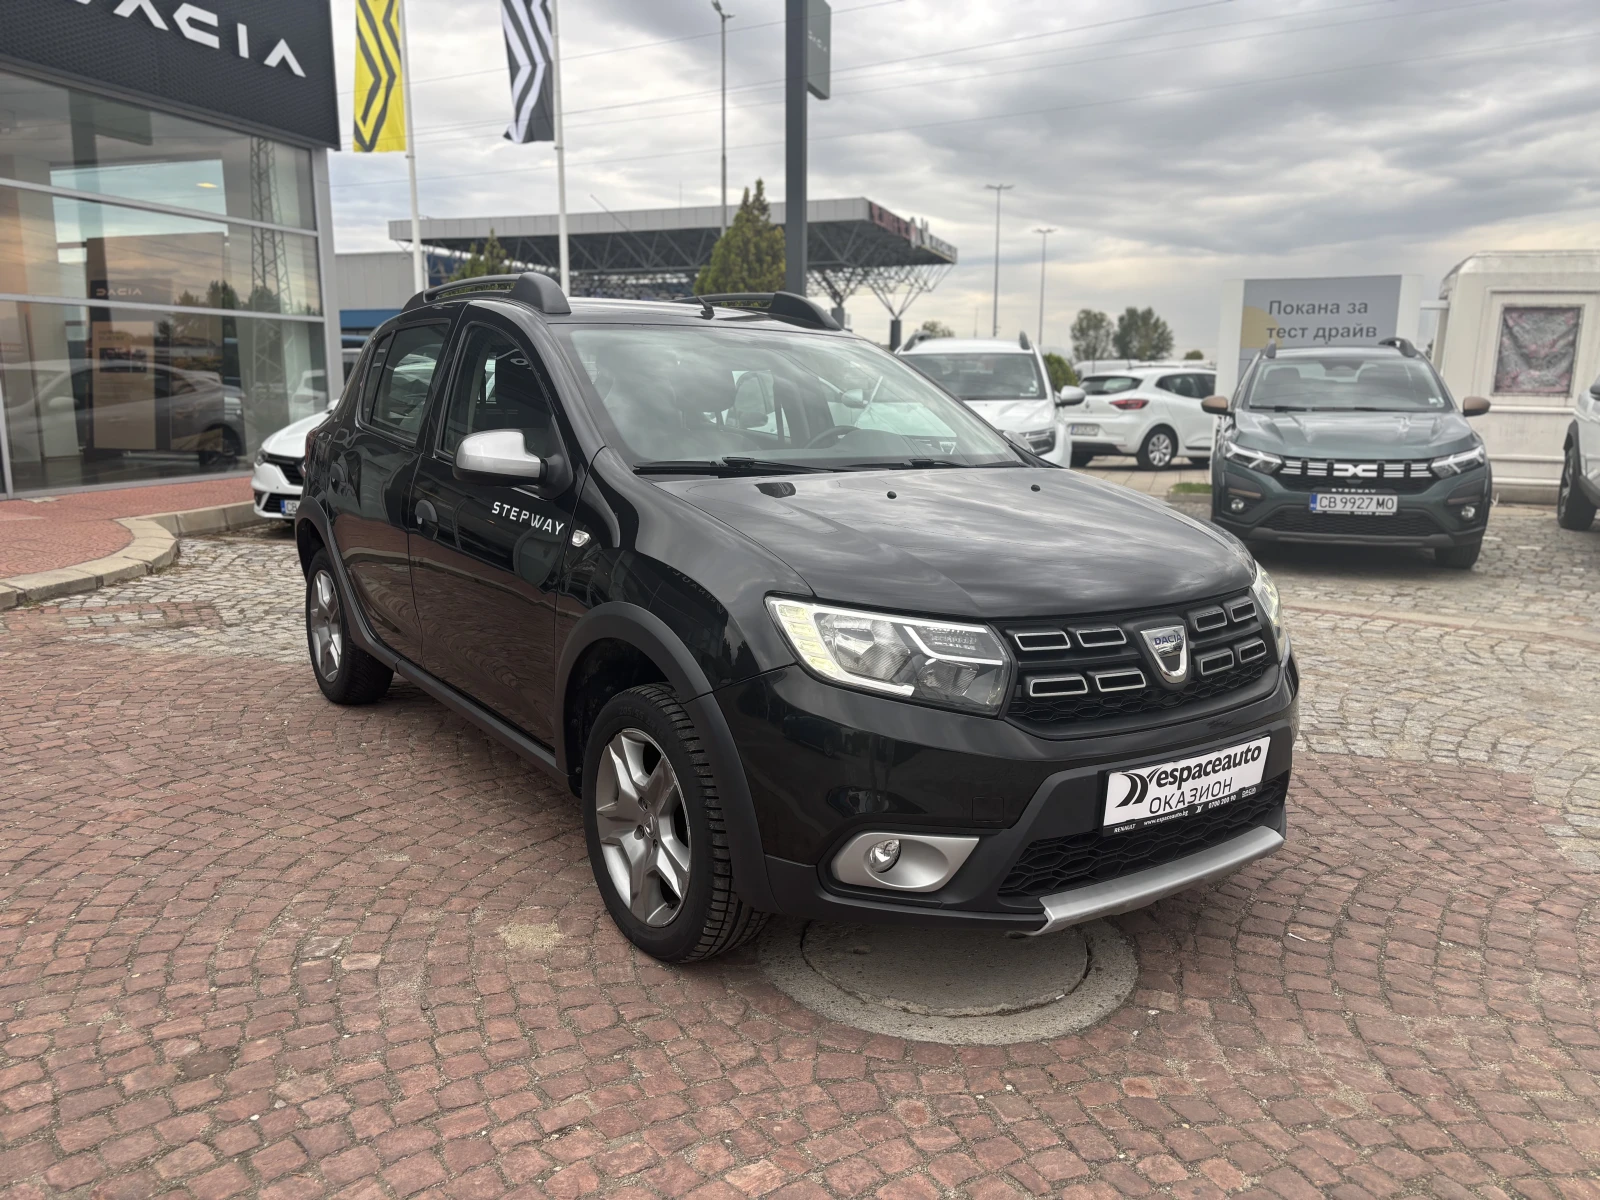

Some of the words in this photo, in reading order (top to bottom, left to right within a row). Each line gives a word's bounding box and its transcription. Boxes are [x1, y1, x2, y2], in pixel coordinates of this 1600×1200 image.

[75, 0, 306, 78] ACIA
[96, 287, 142, 296] DACIA
[1268, 300, 1341, 316] Покана
[1347, 302, 1369, 315] за
[1266, 327, 1309, 339] тест
[1313, 323, 1377, 342] драйв
[1340, 497, 1374, 510] 9927
[1376, 498, 1395, 510] MO
[491, 501, 565, 536] STEPWAY
[1154, 634, 1183, 646] DACIA
[1155, 745, 1262, 790] espaceauto
[1149, 777, 1233, 815] ОКАЗИОН
[1113, 823, 1137, 834] RENAULT
